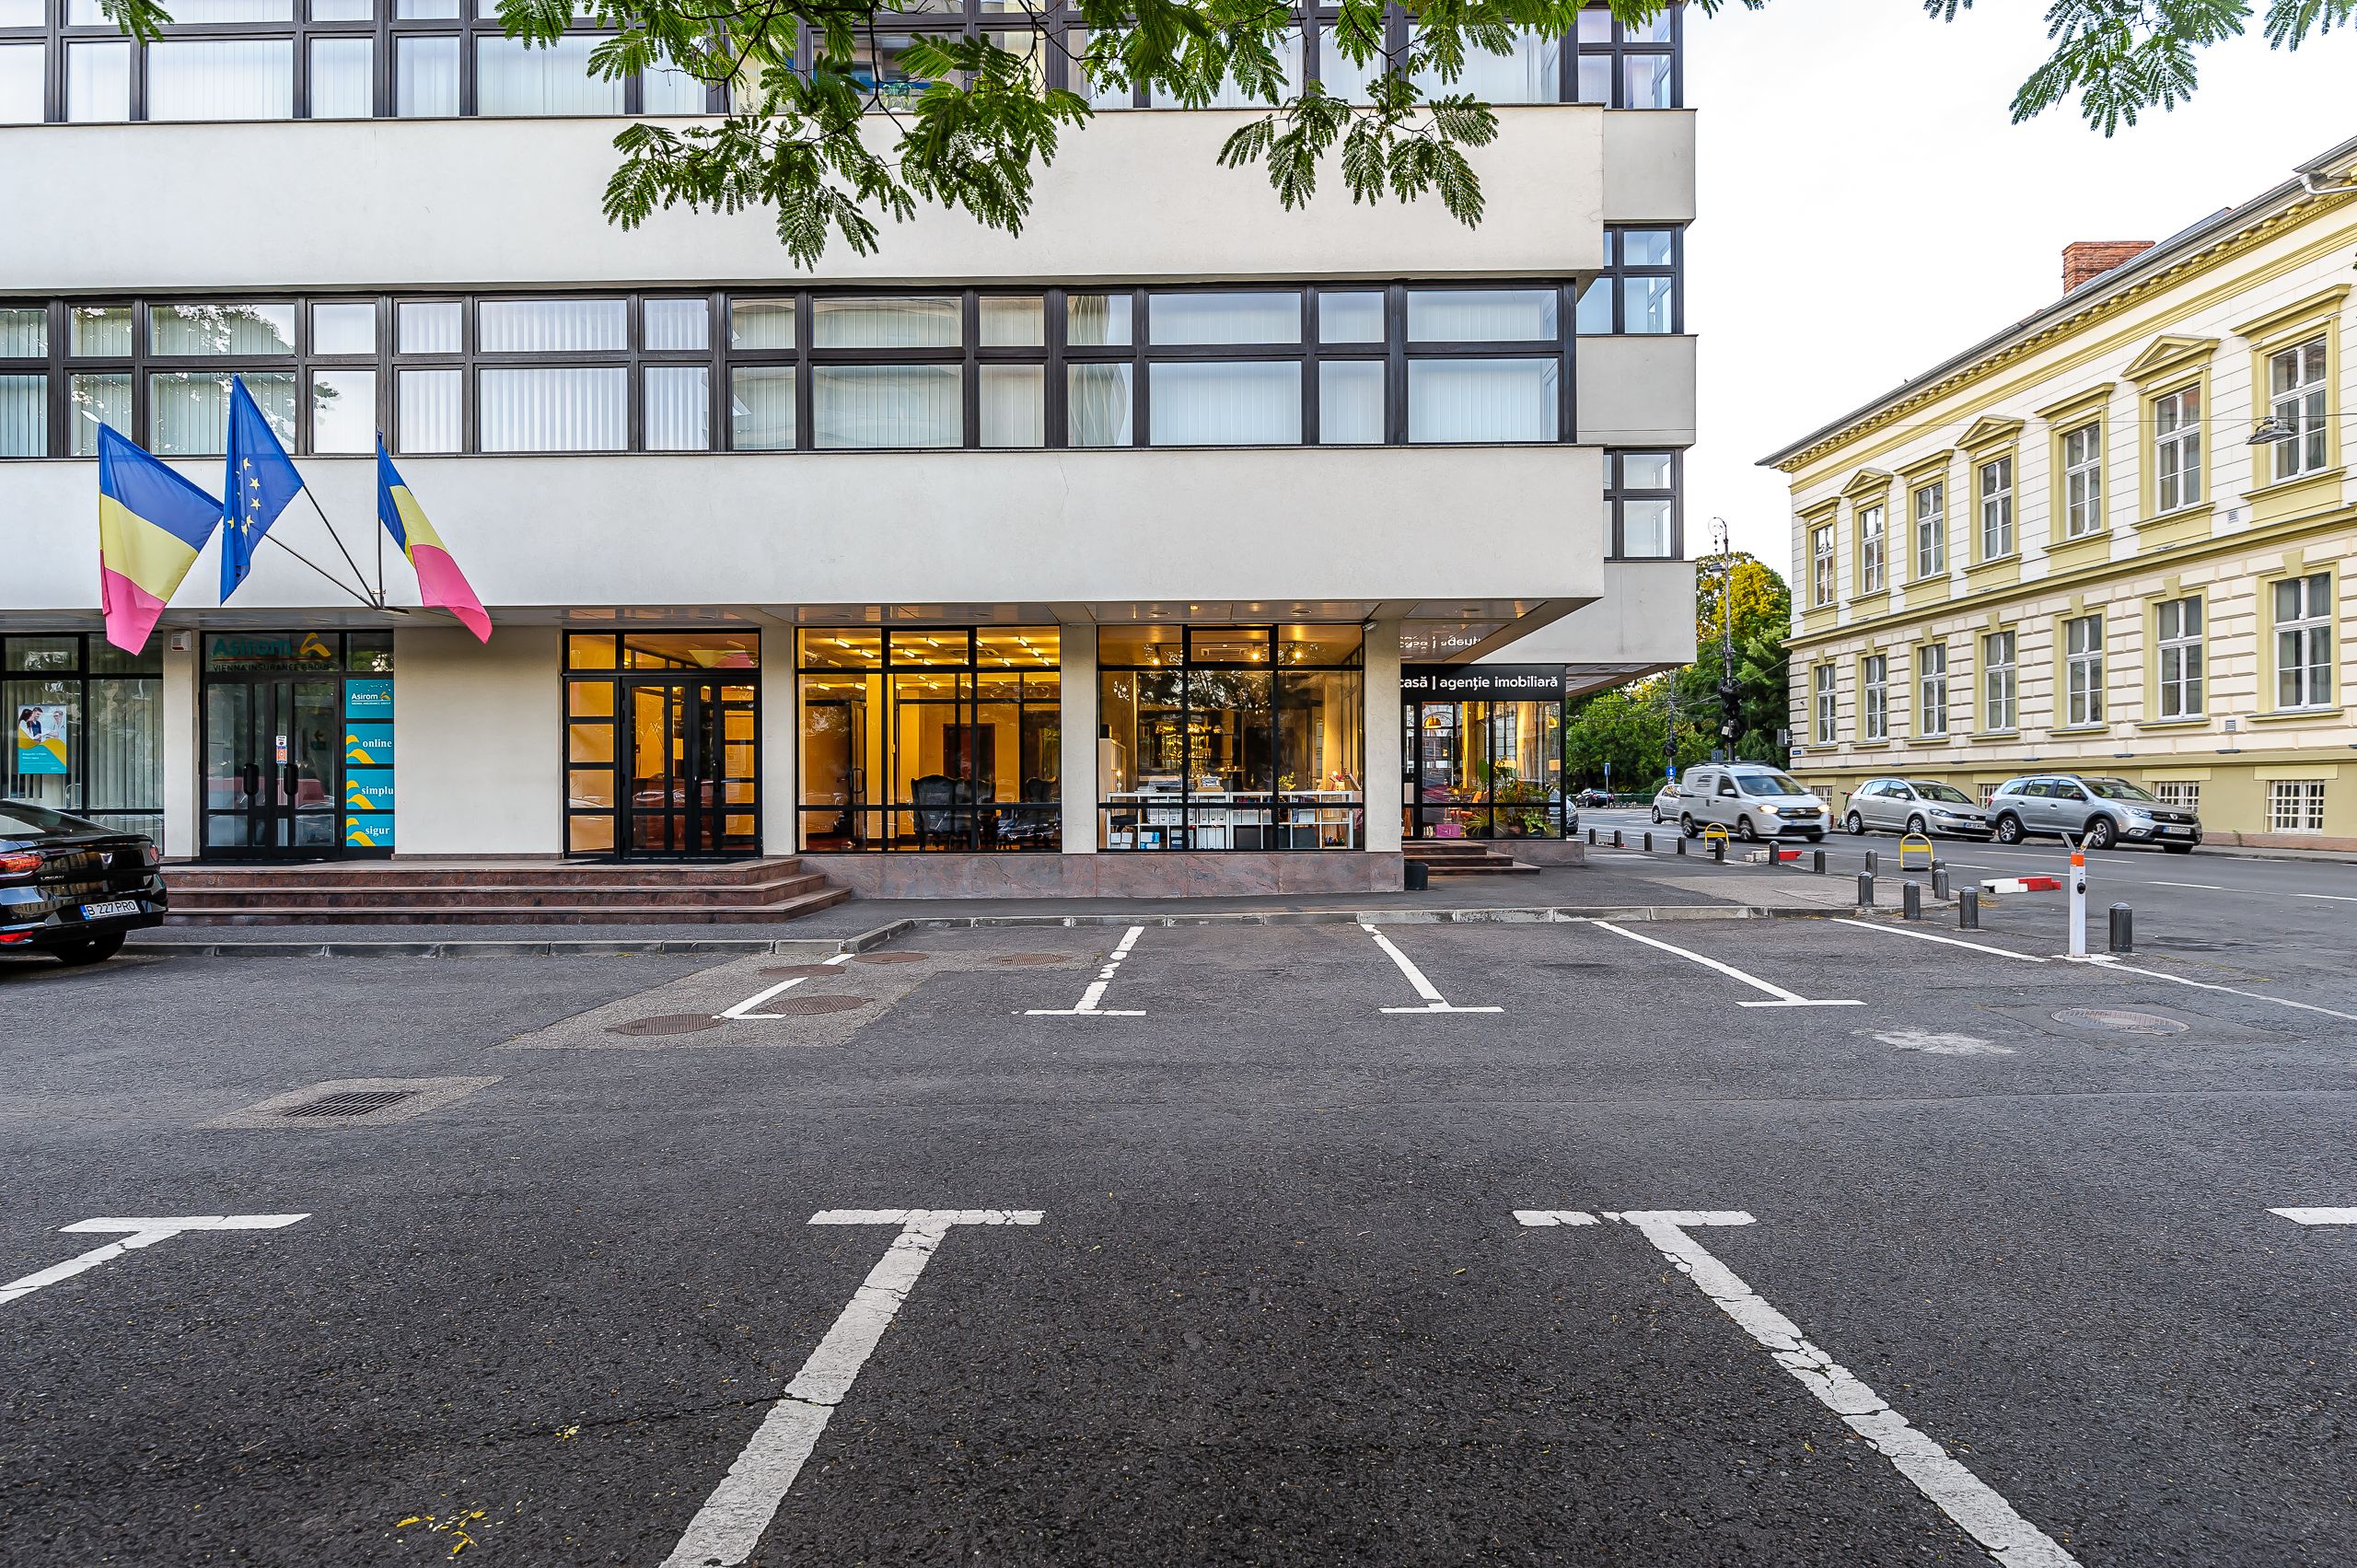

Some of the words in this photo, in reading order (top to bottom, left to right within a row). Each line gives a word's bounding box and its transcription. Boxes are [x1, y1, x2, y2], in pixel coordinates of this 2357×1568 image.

[213, 638, 293, 656] Asirom
[1494, 676, 1558, 689] imobiliară
[362, 738, 392, 748] online
[361, 785, 394, 797] simplu
[365, 825, 390, 838] sigur
[86, 905, 96, 916] B
[96, 901, 114, 914] 227
[115, 900, 136, 912] PRO
